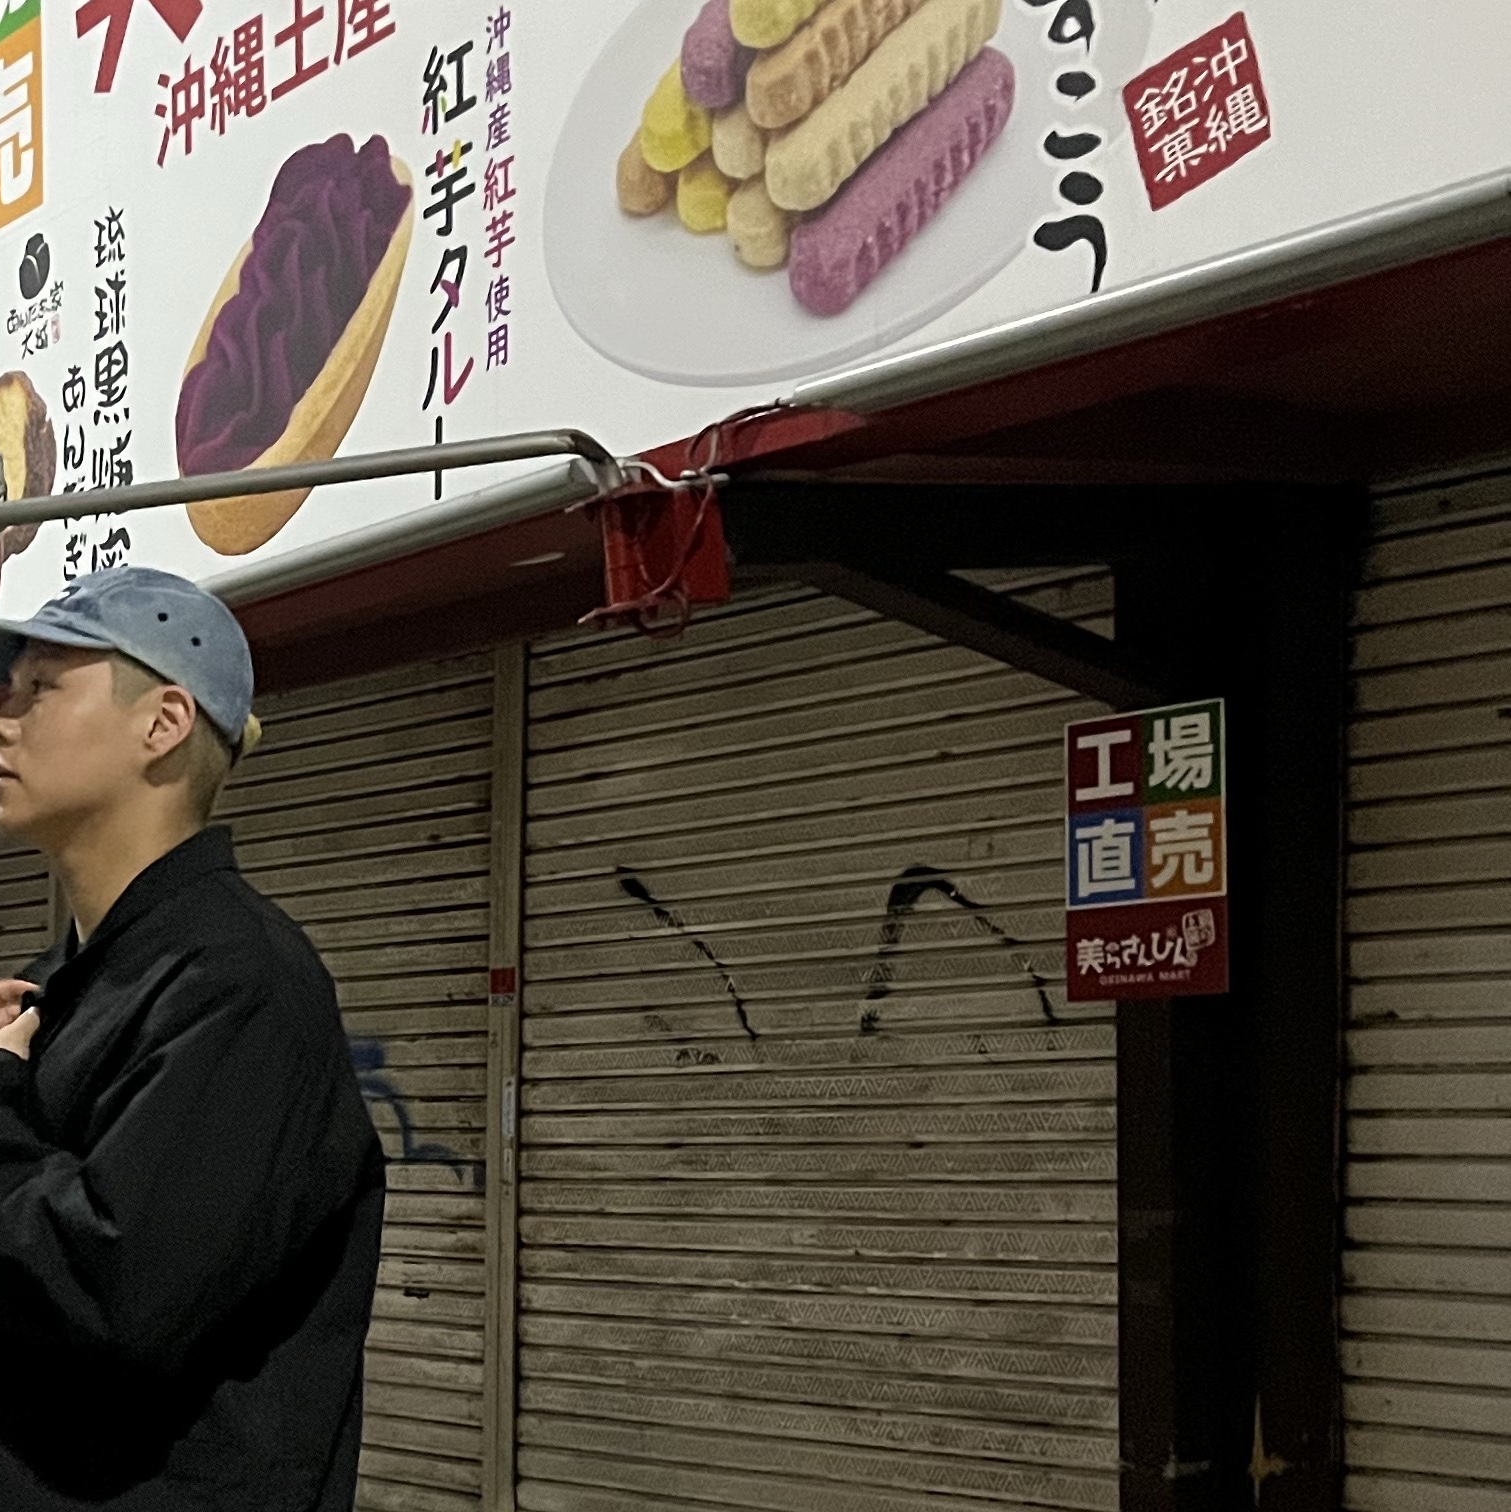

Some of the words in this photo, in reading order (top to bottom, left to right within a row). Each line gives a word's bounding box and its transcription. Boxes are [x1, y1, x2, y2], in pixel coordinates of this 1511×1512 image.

[483, 6, 516, 371] 沖縄産紅芋使用
[1075, 712, 1214, 801] 工場
[1075, 810, 1214, 897] 直売
[1099, 972, 1155, 986] OKINAWA
[1159, 968, 1192, 982] MART
